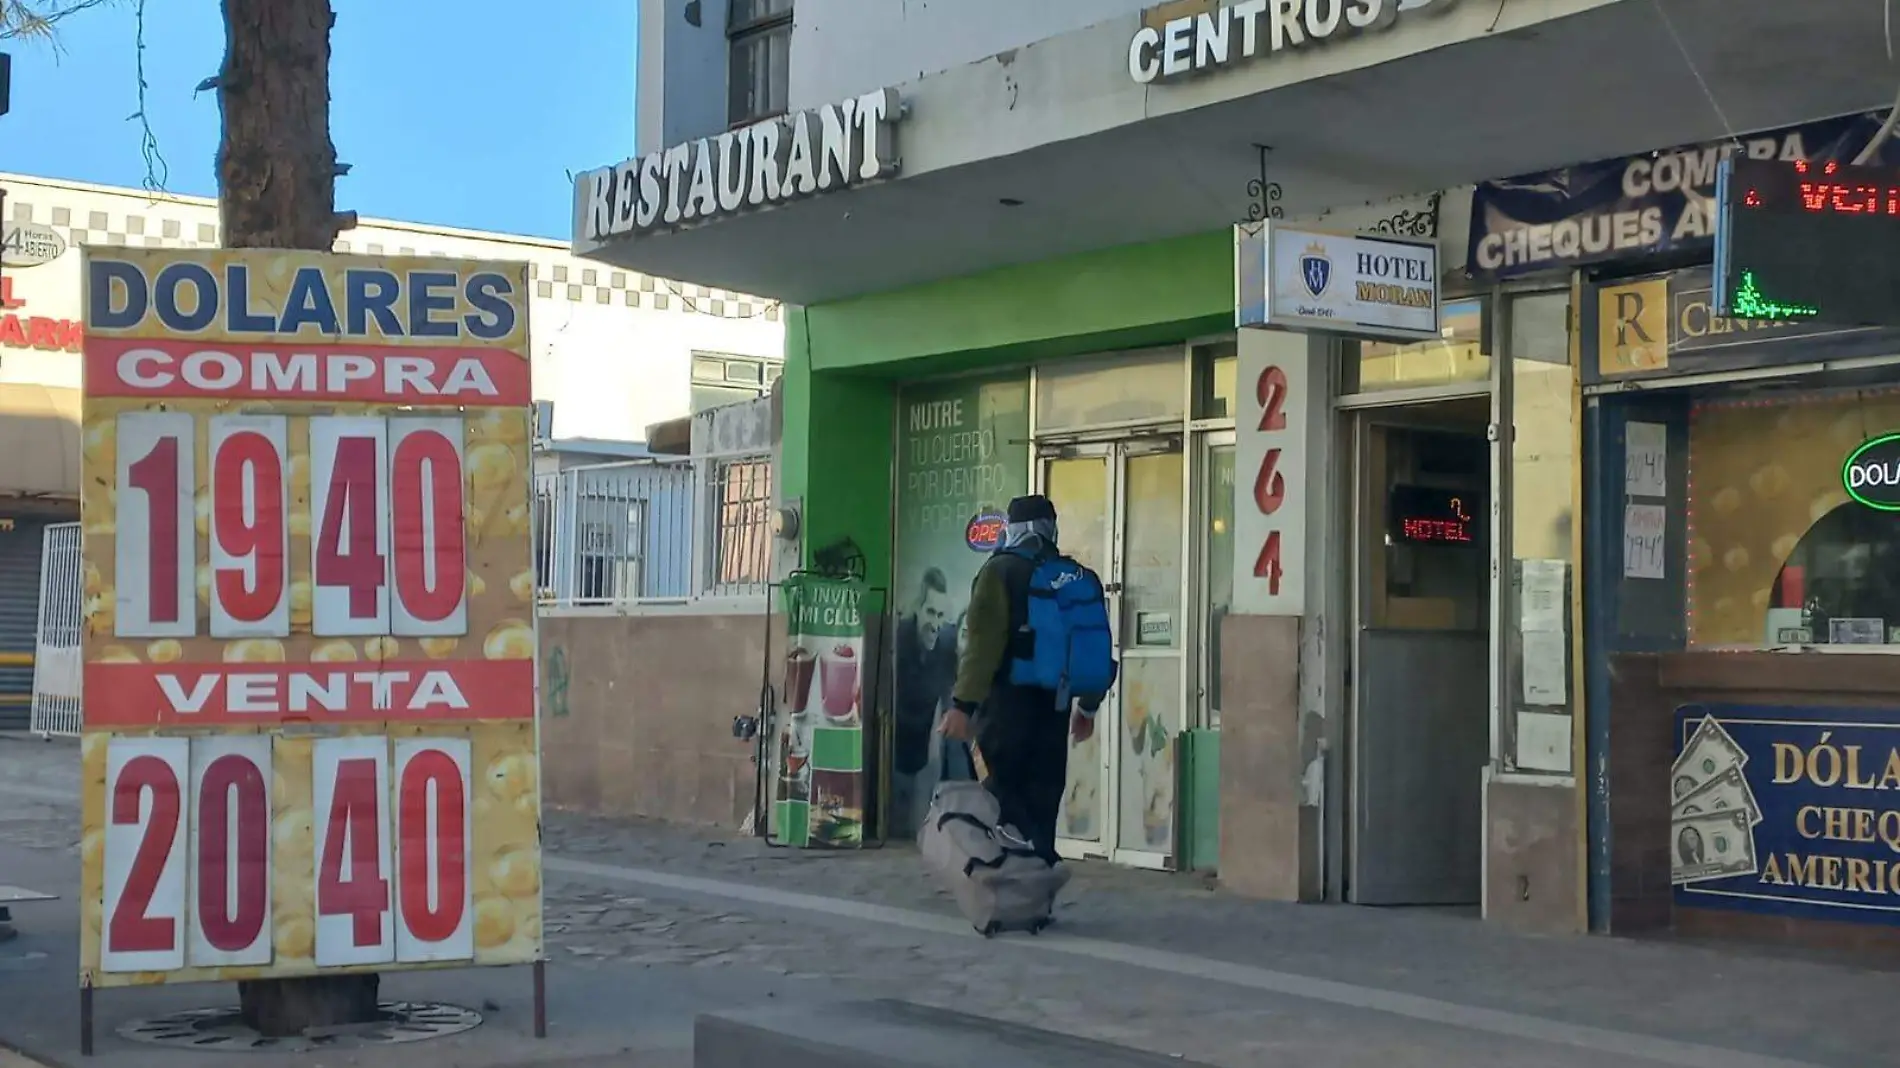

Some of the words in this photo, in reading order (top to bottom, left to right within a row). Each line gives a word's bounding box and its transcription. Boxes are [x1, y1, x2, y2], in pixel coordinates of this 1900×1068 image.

[585, 88, 888, 240] RESTAURANT
[24, 240, 59, 260] ABIERTO
[1476, 209, 1662, 269] CHEQUES
[1356, 252, 1433, 282] HOTEL
[88, 259, 516, 339] DOLARES
[1355, 280, 1432, 309] MORAN
[1614, 292, 1656, 347] R
[116, 348, 499, 396] COMPRA
[910, 399, 963, 432] NUTRE
[910, 437, 928, 466] TU
[908, 470, 939, 500] POR
[943, 463, 1006, 498] DENTRO
[1404, 518, 1471, 541] HOTEL
[823, 607, 861, 627] CLUB
[155, 670, 470, 714] VENTA
[1771, 731, 1900, 790] DÓLA
[1795, 805, 1900, 853] CHEQ
